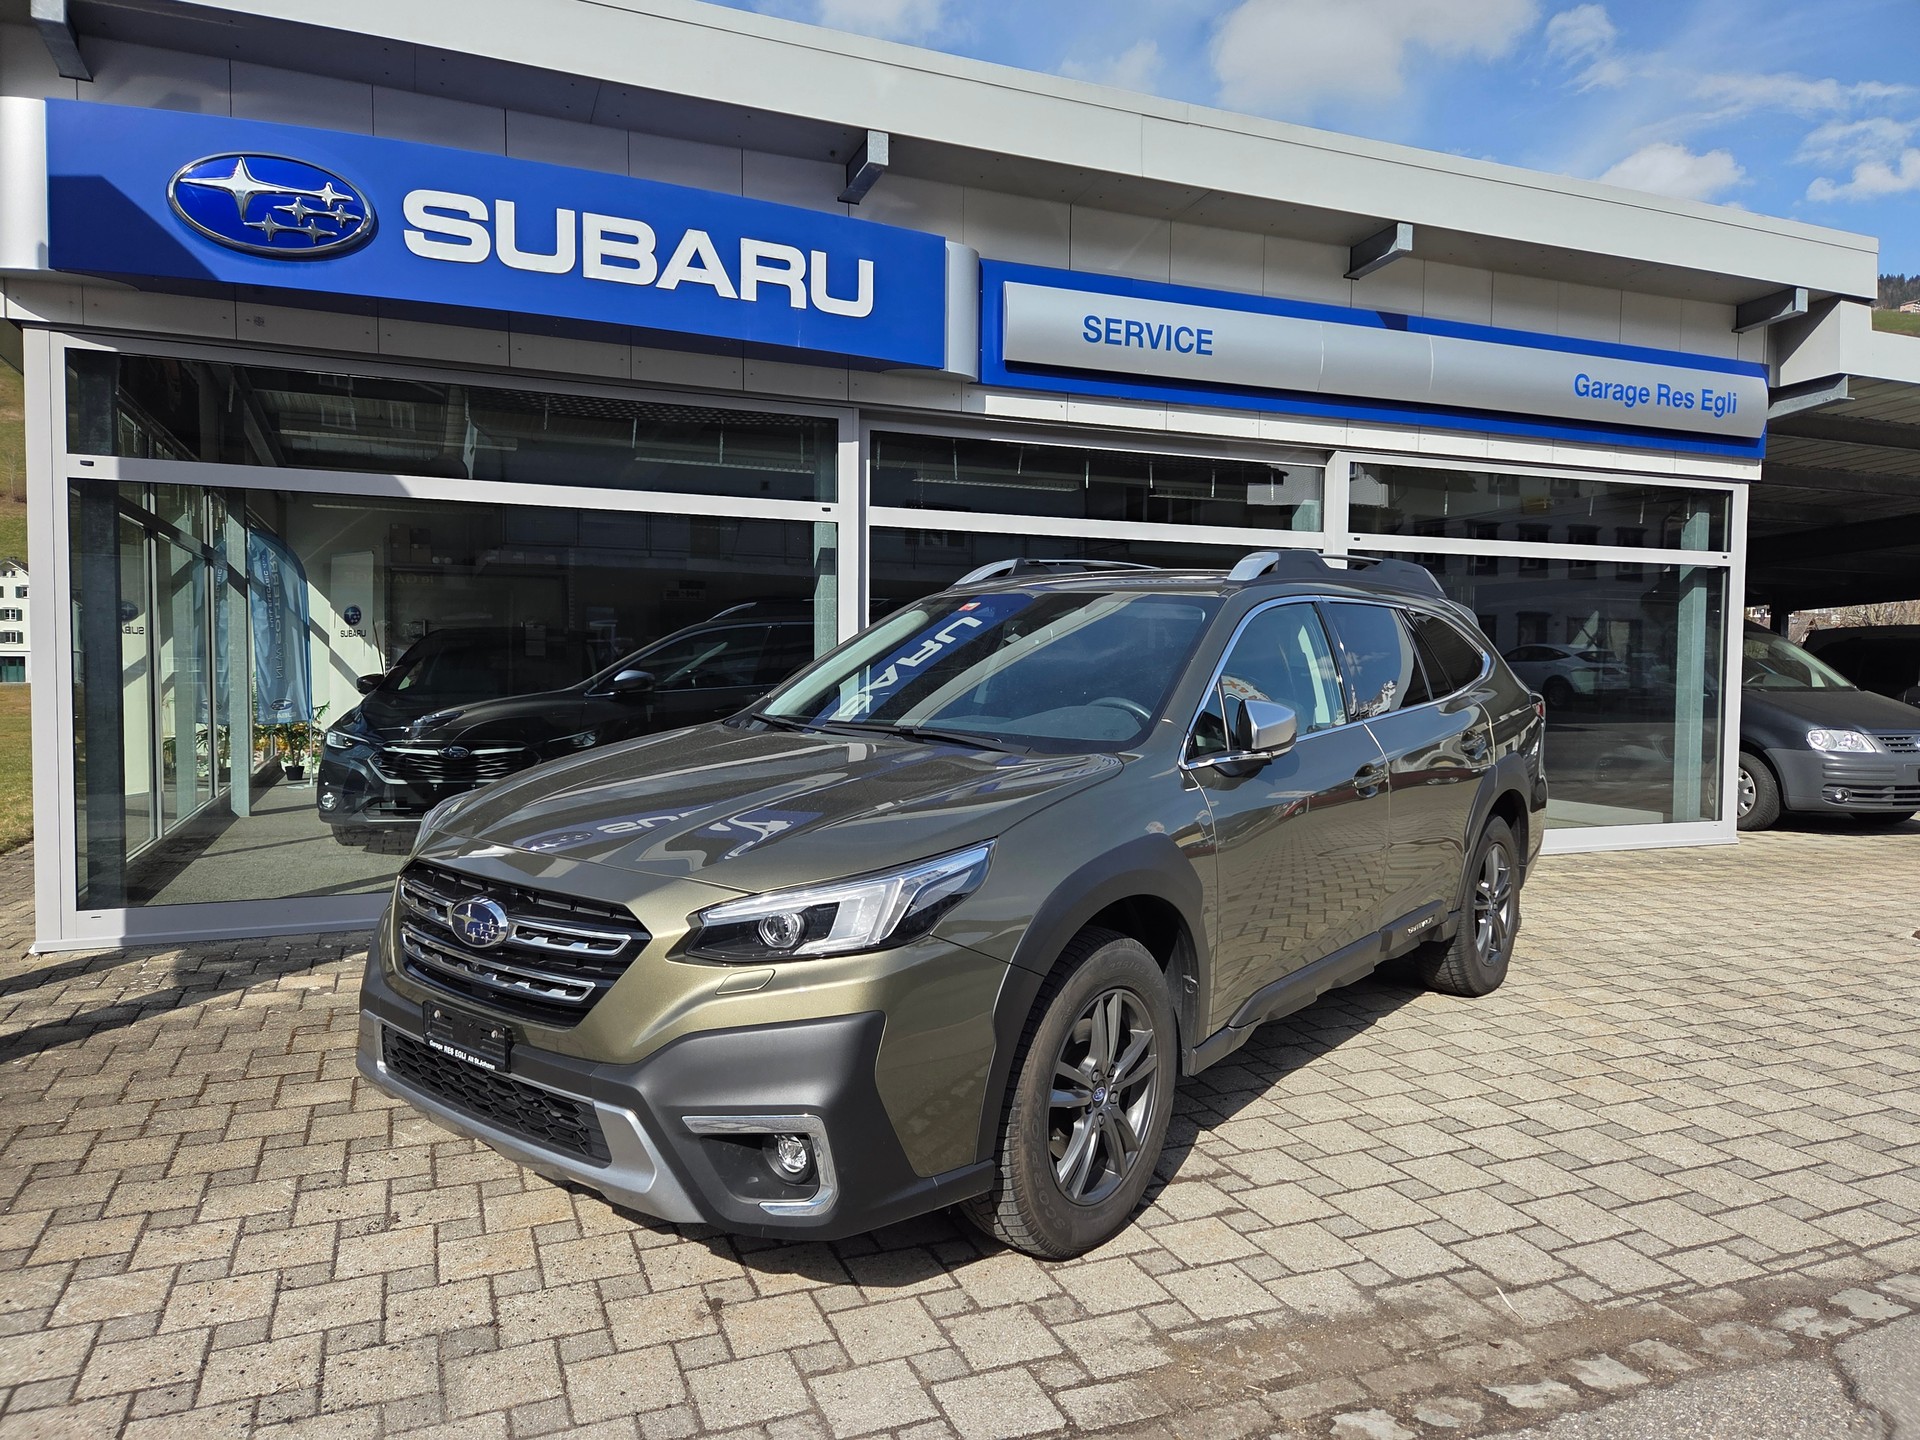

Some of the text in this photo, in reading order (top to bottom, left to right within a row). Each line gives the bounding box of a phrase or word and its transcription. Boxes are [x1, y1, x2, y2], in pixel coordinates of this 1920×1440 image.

[403, 189, 874, 317] SUBARU
[1083, 315, 1213, 355] SERVICE
[1574, 373, 1737, 418] Garage Res Egli
[340, 630, 366, 638] SUBARU
[429, 1039, 443, 1051] Garage
[443, 1045, 455, 1056] RES
[454, 1049, 467, 1060] EGLI
[1032, 1090, 1065, 1230] SCORPION
